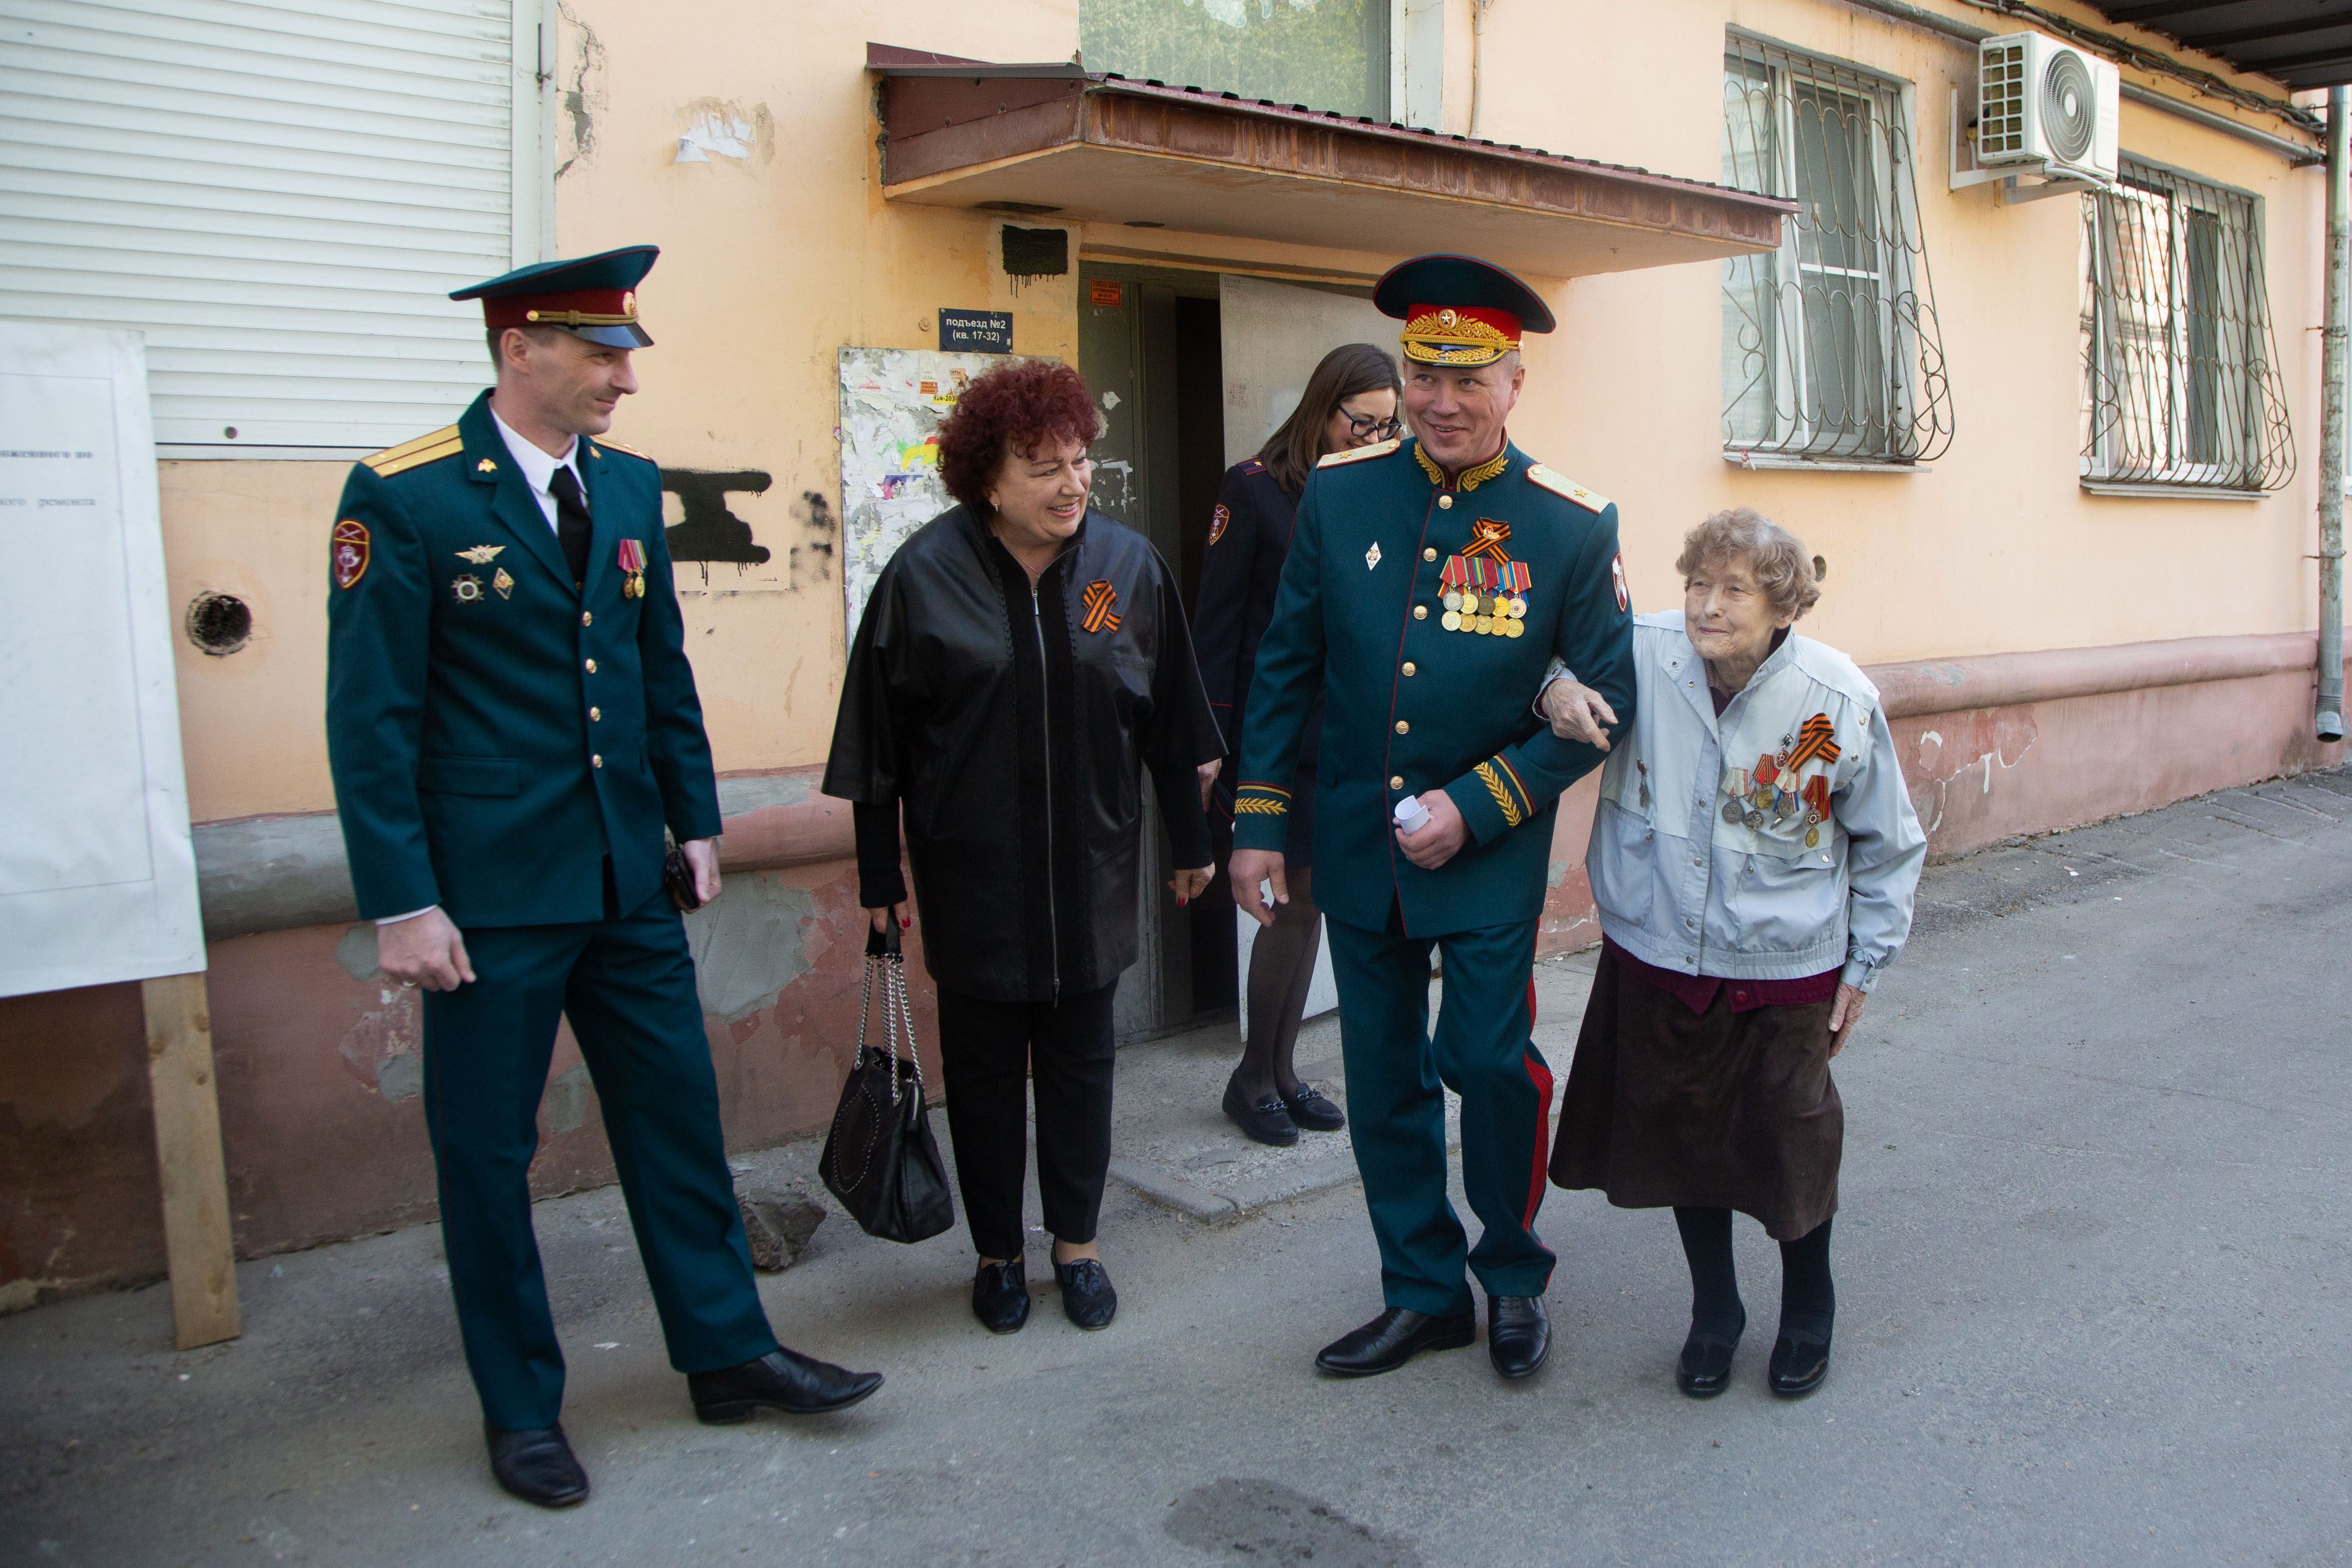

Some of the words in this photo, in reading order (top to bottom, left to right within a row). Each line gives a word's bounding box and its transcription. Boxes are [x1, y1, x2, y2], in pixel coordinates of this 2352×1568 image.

[946, 319, 987, 329] подъезд
[990, 319, 1006, 329] №2
[952, 329, 969, 341] (кв.
[972, 331, 1000, 343] 17-32)
